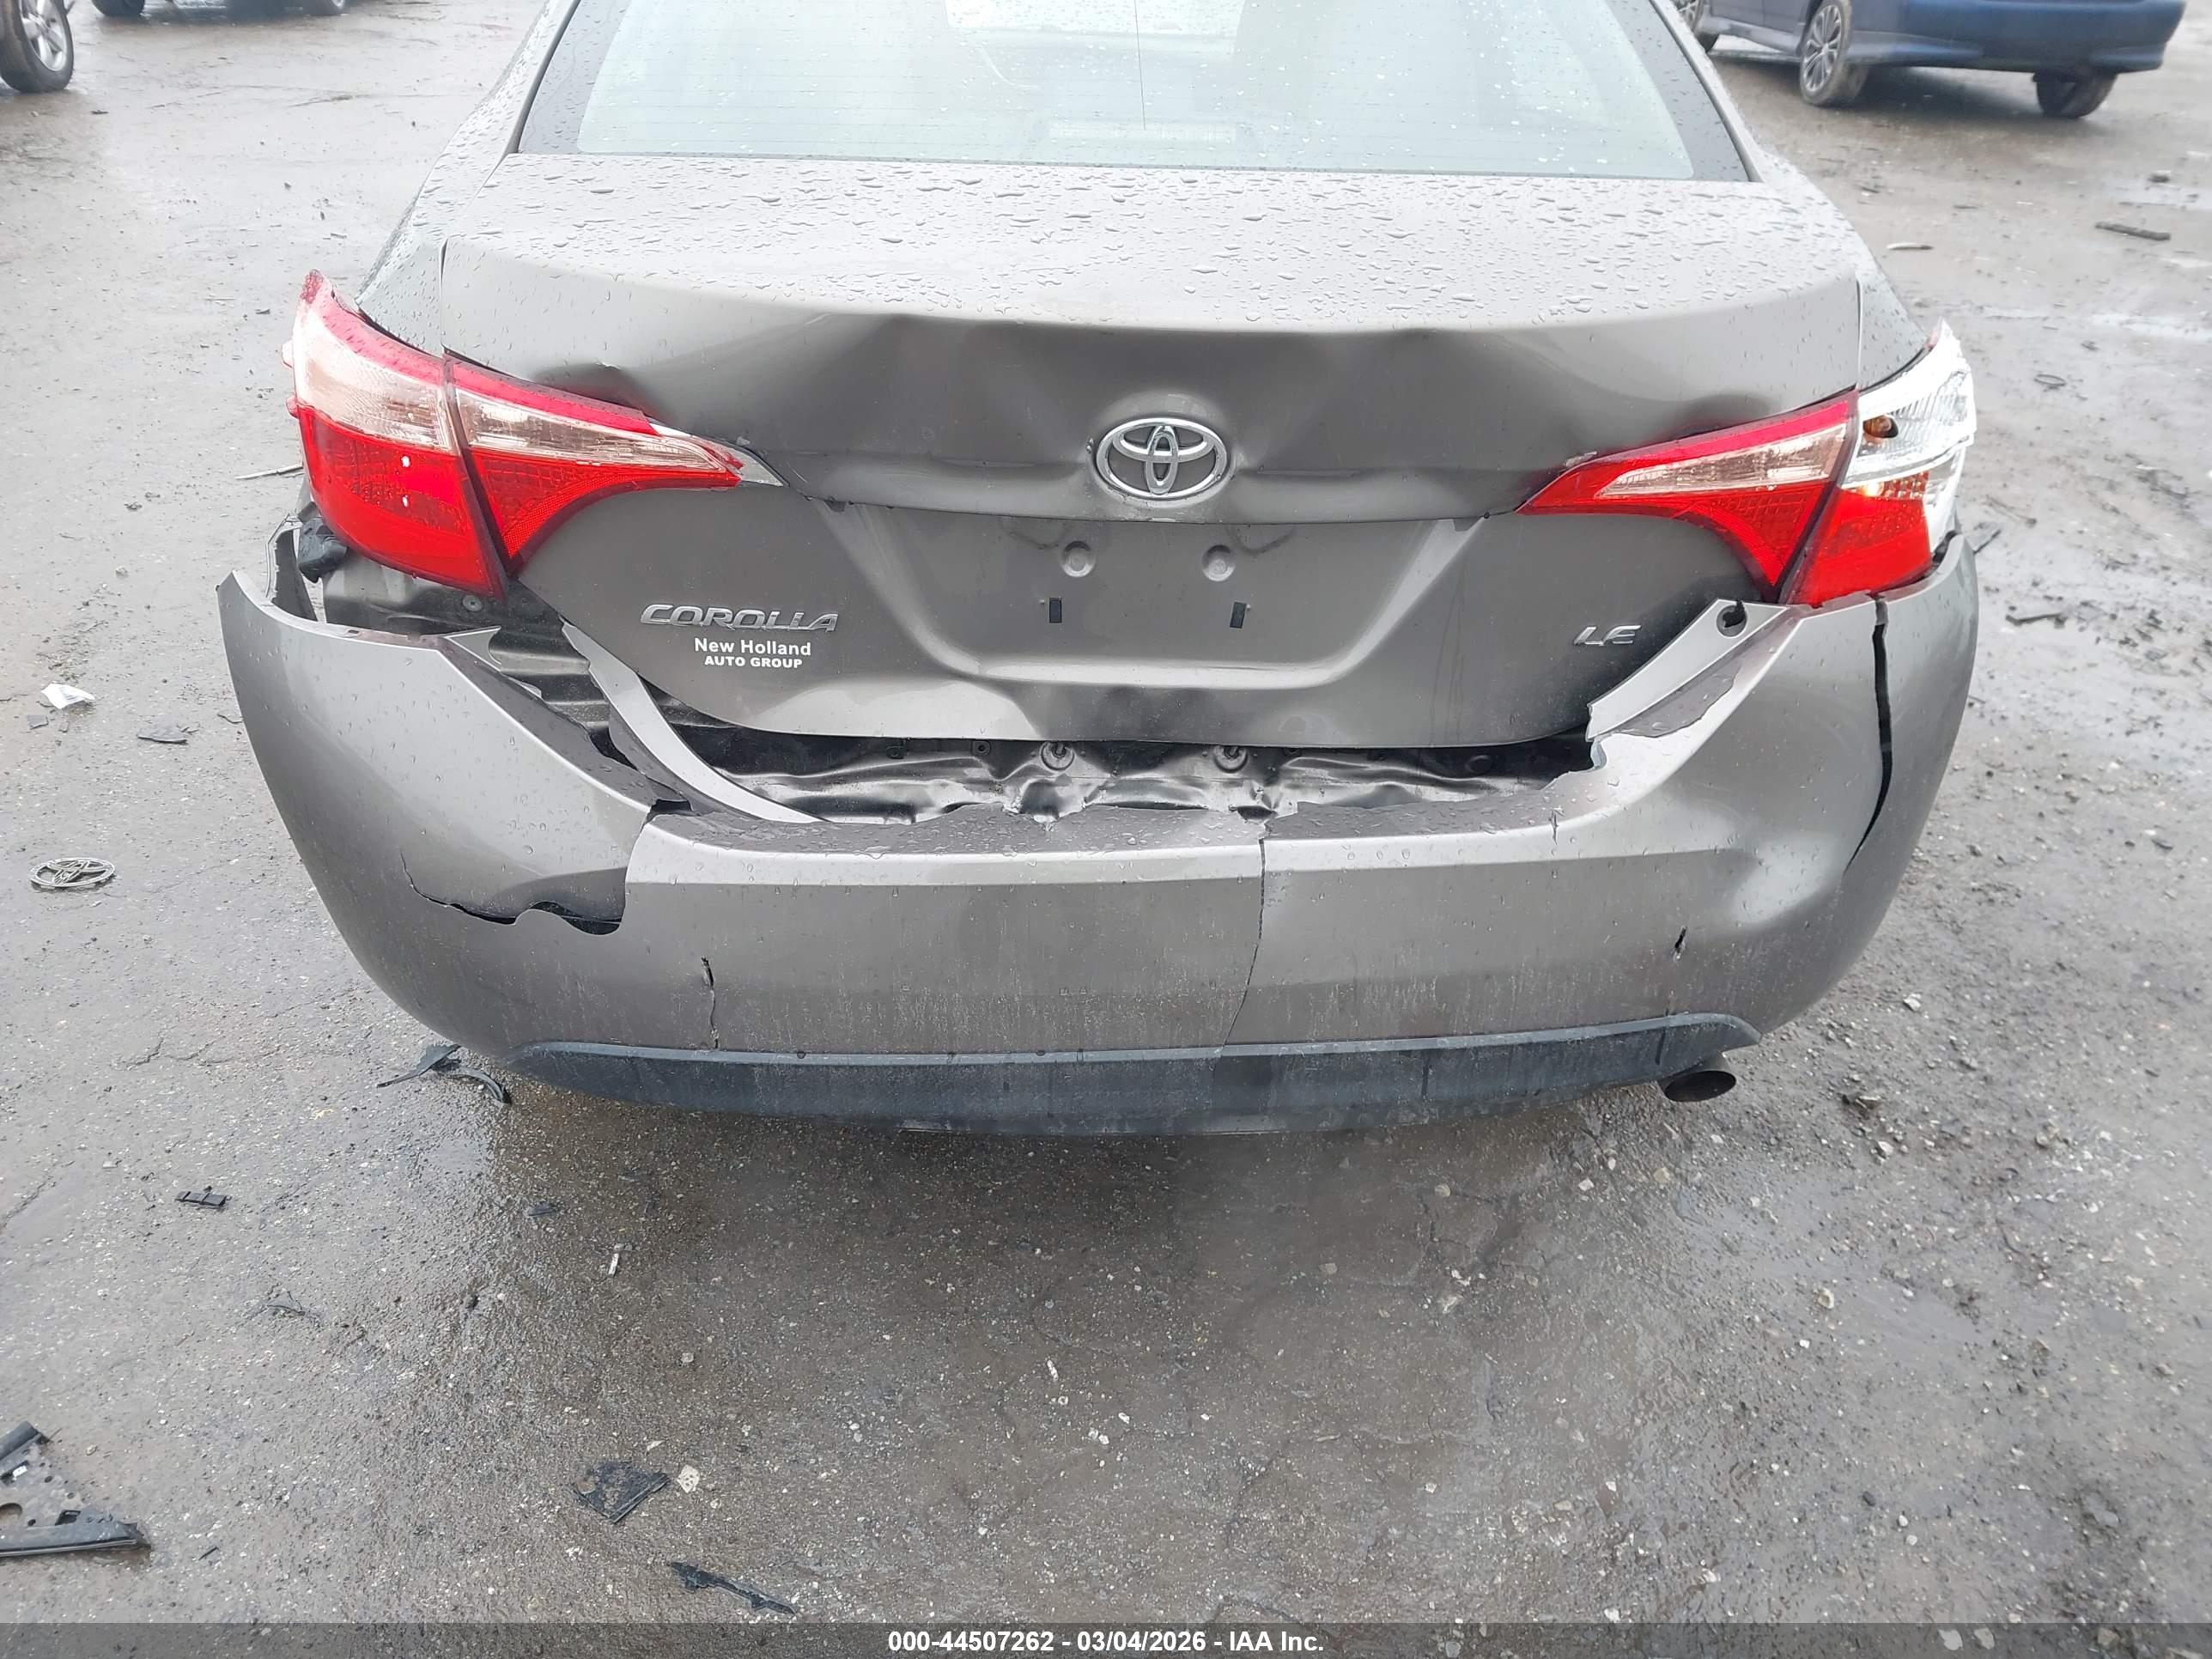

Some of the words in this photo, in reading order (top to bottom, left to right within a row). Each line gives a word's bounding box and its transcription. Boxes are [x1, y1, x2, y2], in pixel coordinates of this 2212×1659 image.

[641, 604, 839, 632] COROLLA
[1573, 624, 1642, 646] LE
[694, 637, 734, 653] New
[740, 640, 811, 656] Holland
[704, 655, 745, 667] AUTO
[750, 657, 803, 669] GROUP
